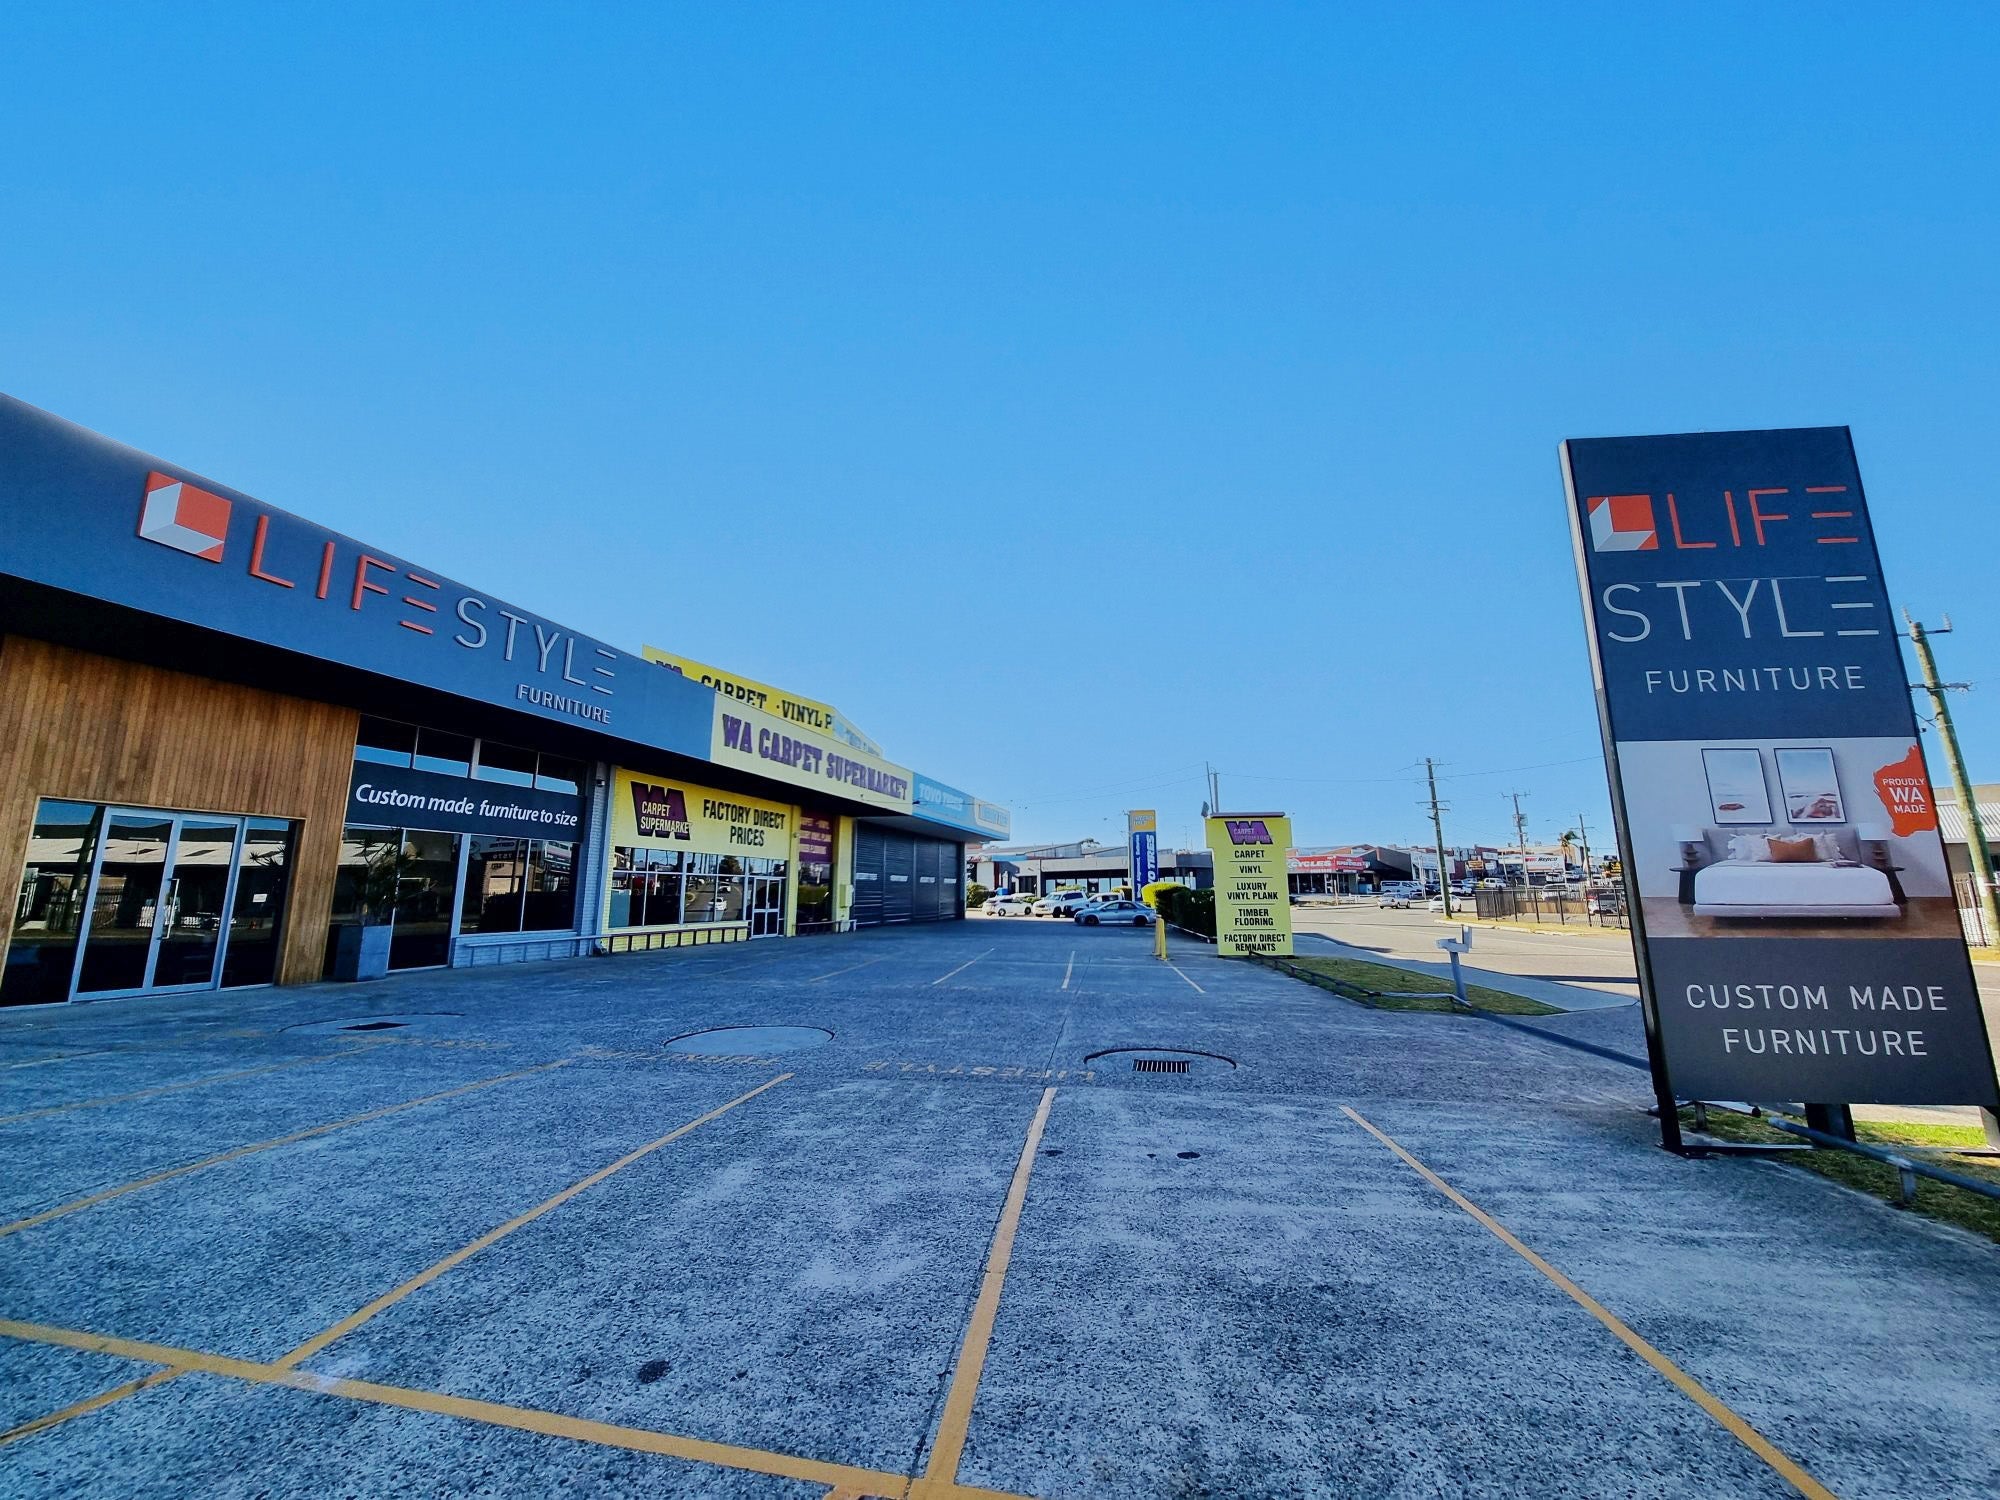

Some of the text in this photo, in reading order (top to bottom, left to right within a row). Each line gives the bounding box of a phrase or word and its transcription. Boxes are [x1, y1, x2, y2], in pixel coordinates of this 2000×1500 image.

[1667, 486, 1860, 549] LIFE
[1602, 576, 1880, 642] STYLE
[1645, 666, 1865, 693] FURNITURE
[516, 683, 611, 725] FURNITURE
[722, 713, 752, 755] WA
[758, 727, 823, 775] CARPET
[827, 752, 908, 801] SUPERMARKET
[1882, 778, 1925, 786] PROUDLY
[1889, 787, 1925, 803] WA
[355, 784, 578, 827] Custom made furniture to size
[642, 801, 671, 817] CARPET
[1893, 805, 1928, 814] MADE
[703, 799, 750, 824] FACTORY
[753, 808, 786, 830] DIRECT
[729, 825, 765, 847] PRICES
[1234, 850, 1264, 858] CARPET
[1239, 866, 1262, 874] VINYL
[1237, 882, 1267, 891] LUXURY
[1227, 892, 1279, 900] VINYL PLANK
[1238, 908, 1269, 917] TIMBER
[1235, 917, 1274, 926] FLOORING
[1224, 934, 1286, 943] FACTORY DIRECT
[1235, 943, 1276, 952] REMNANTS
[1686, 984, 1948, 1011] CUSTOM MADE
[1722, 1028, 1928, 1056] FURNITURE
